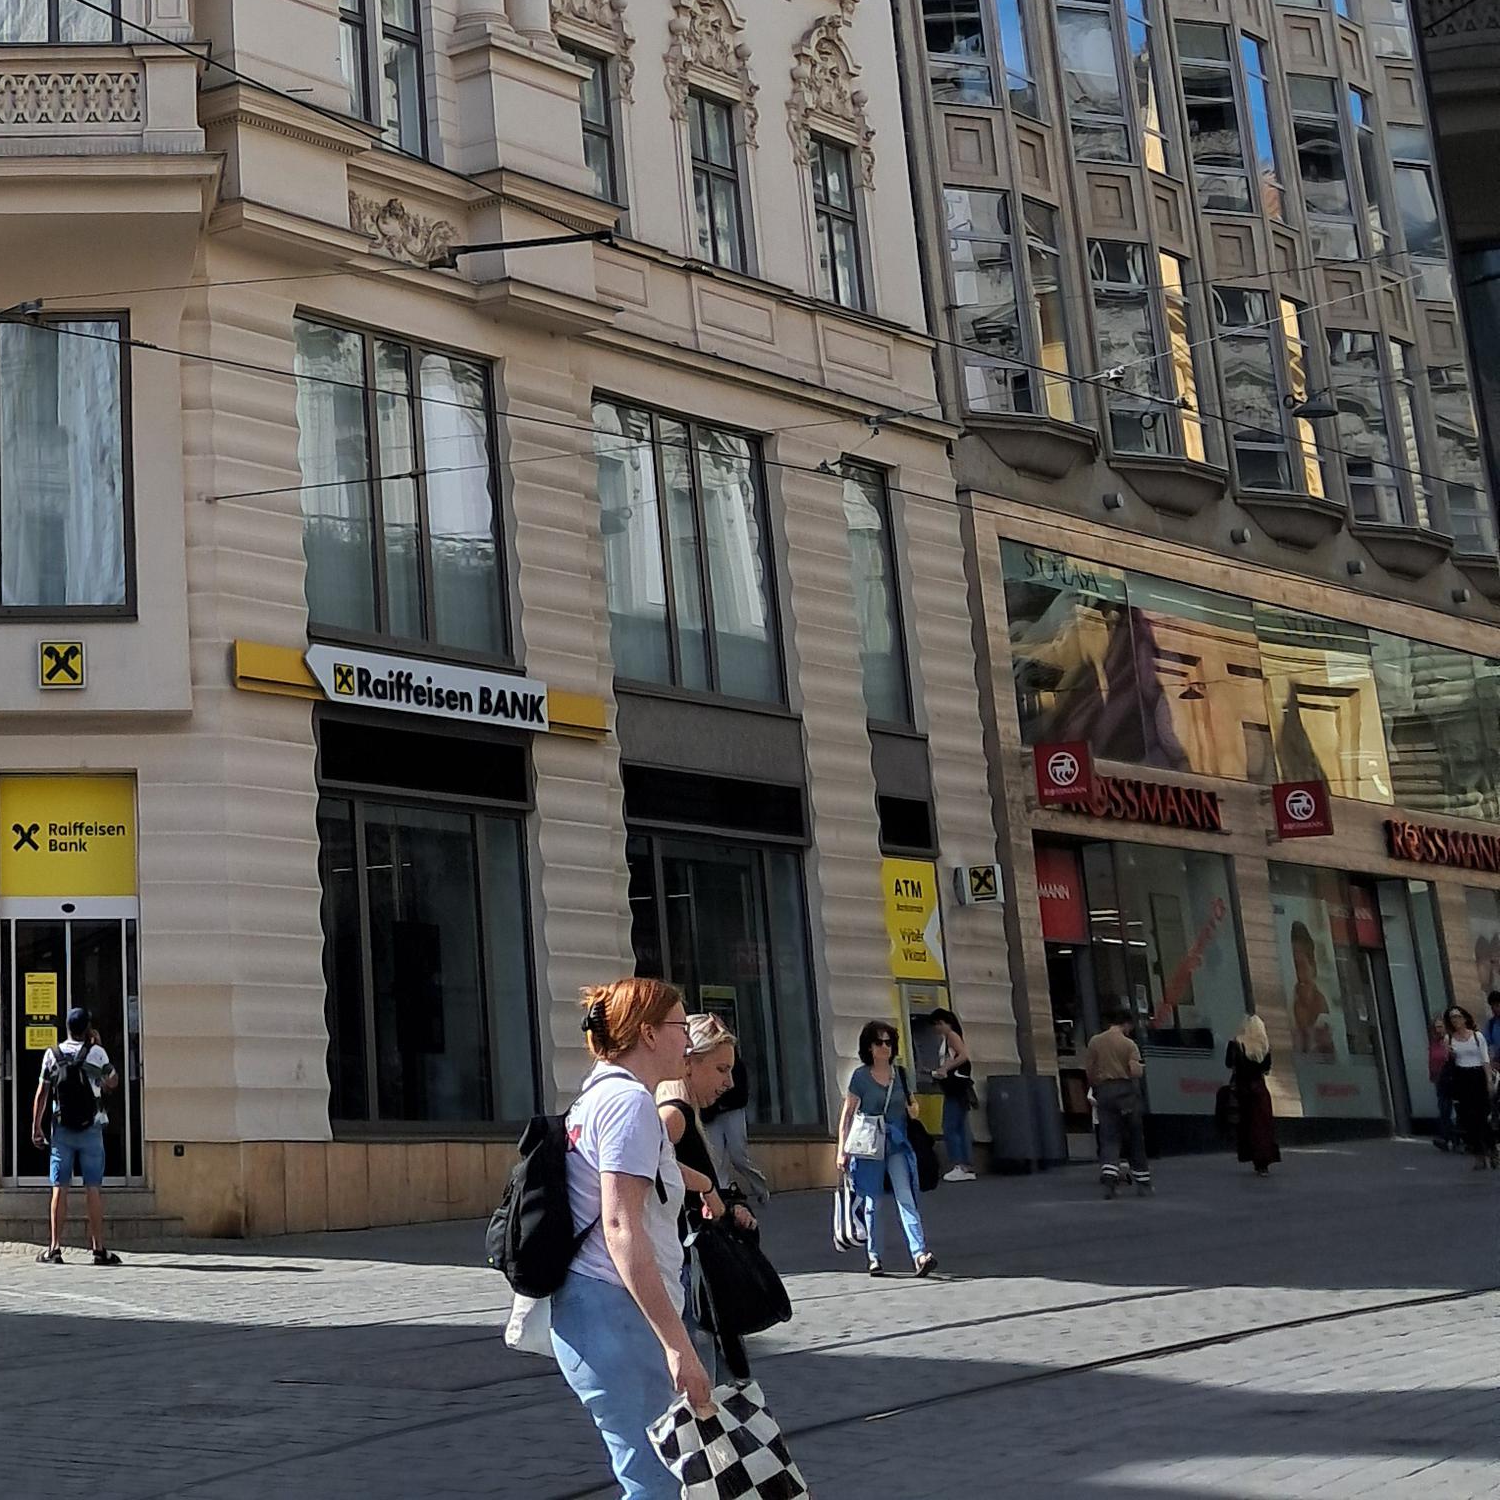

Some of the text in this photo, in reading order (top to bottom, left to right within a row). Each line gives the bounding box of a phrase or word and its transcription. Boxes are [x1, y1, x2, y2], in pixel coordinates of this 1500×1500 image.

[357, 667, 545, 723] Raiffeisen BANK
[48, 822, 125, 836] Raiffeisen
[48, 838, 88, 852] Bank
[894, 879, 923, 898] ATM
